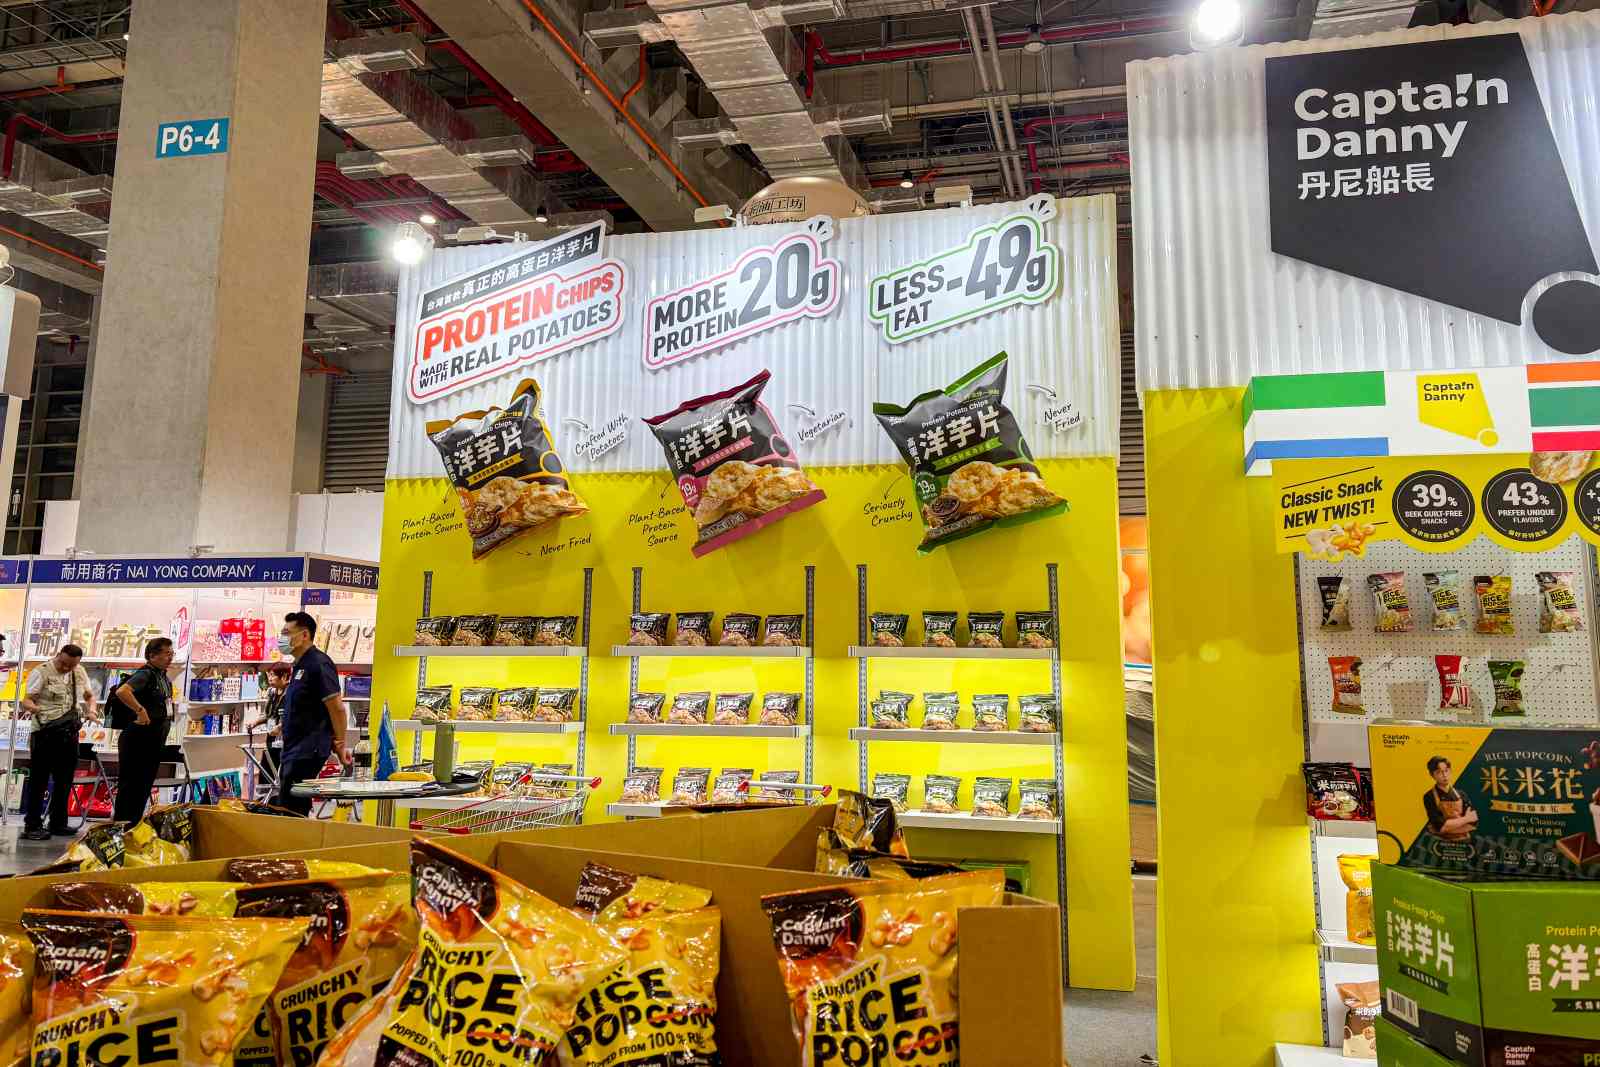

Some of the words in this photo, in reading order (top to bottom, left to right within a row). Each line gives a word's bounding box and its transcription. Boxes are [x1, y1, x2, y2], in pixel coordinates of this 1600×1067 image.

[161, 122, 220, 154] P6-4
[1296, 120, 1468, 161] Danny
[1298, 162, 1435, 200] 丹尼船長
[462, 233, 594, 298] 真正的高蛋白洋芋片
[738, 242, 831, 327] 20g
[877, 264, 945, 312] LESS
[422, 281, 556, 361] PROTEIN
[556, 270, 615, 310] CHIPS
[653, 281, 728, 333] MORE
[894, 299, 933, 333] FAT
[450, 341, 503, 378] REAL
[507, 299, 612, 356] POTATOES
[653, 308, 738, 358] PROTEIN
[419, 371, 448, 390] WITH
[420, 359, 449, 378] MADE
[1044, 402, 1072, 423] Never
[1423, 392, 1466, 403] Danny
[575, 429, 606, 456] Crafted
[606, 415, 629, 434] With
[679, 410, 753, 463] 洋芋片
[797, 410, 846, 441] Vegetarian
[919, 405, 1001, 460] 洋芋片
[921, 416, 946, 429] Protein
[1055, 412, 1081, 432] Fried
[454, 423, 523, 476] 洋芋片
[591, 431, 625, 460] Potatoes
[863, 498, 906, 515] Seriously
[1281, 485, 1334, 509] Classic
[1337, 476, 1383, 496] Snack
[1412, 482, 1459, 508] 39%
[1502, 481, 1550, 507] 43%
[402, 508, 456, 530] Plant-Based
[628, 505, 686, 525] Plant-Based
[871, 511, 913, 527] Crunchy
[1283, 511, 1320, 530] NEW
[1322, 499, 1375, 525] TWIST!
[1405, 510, 1423, 518] SEEK
[1423, 510, 1463, 518] GUILT-FREE
[1497, 509, 1526, 517] PREFER
[1526, 508, 1556, 516] UNIQUE
[1512, 516, 1544, 524] FLAVORS
[400, 528, 433, 543] Protein
[434, 522, 464, 537] Source
[642, 522, 677, 536] Protein
[647, 534, 679, 548] Source
[540, 543, 566, 556] Never
[567, 534, 592, 548] Fried
[61, 563, 122, 581] 耐用商行
[126, 565, 149, 579] NAI
[152, 564, 189, 579] YONG
[191, 563, 257, 578] COMPANY
[263, 570, 294, 582] P1127
[330, 564, 374, 586] 耐用商行
[1484, 751, 1513, 762] RICE
[1515, 750, 1574, 764] POPCORN
[1480, 766, 1585, 800] 米米花
[781, 931, 835, 948] Danny
[1394, 914, 1455, 977] 洋芋片
[1546, 926, 1586, 937] Protein
[423, 930, 495, 967] CRUNCHY
[415, 945, 526, 1016] RICE
[812, 962, 880, 1002] CRUNCHY
[1527, 943, 1542, 992] 高蛋白
[1547, 943, 1600, 991] 洋
[281, 965, 363, 1010] CRUNCHY
[815, 973, 929, 1034] RICE
[34, 1003, 128, 1047] CRUNCHY
[390, 1022, 427, 1047] POPPED
[397, 979, 558, 1066] POPCORN
[618, 1042, 647, 1057] FROM
[647, 1031, 686, 1050] 100%
[812, 1021, 960, 1067] POPCOR
[1505, 1052, 1530, 1060] Danny
